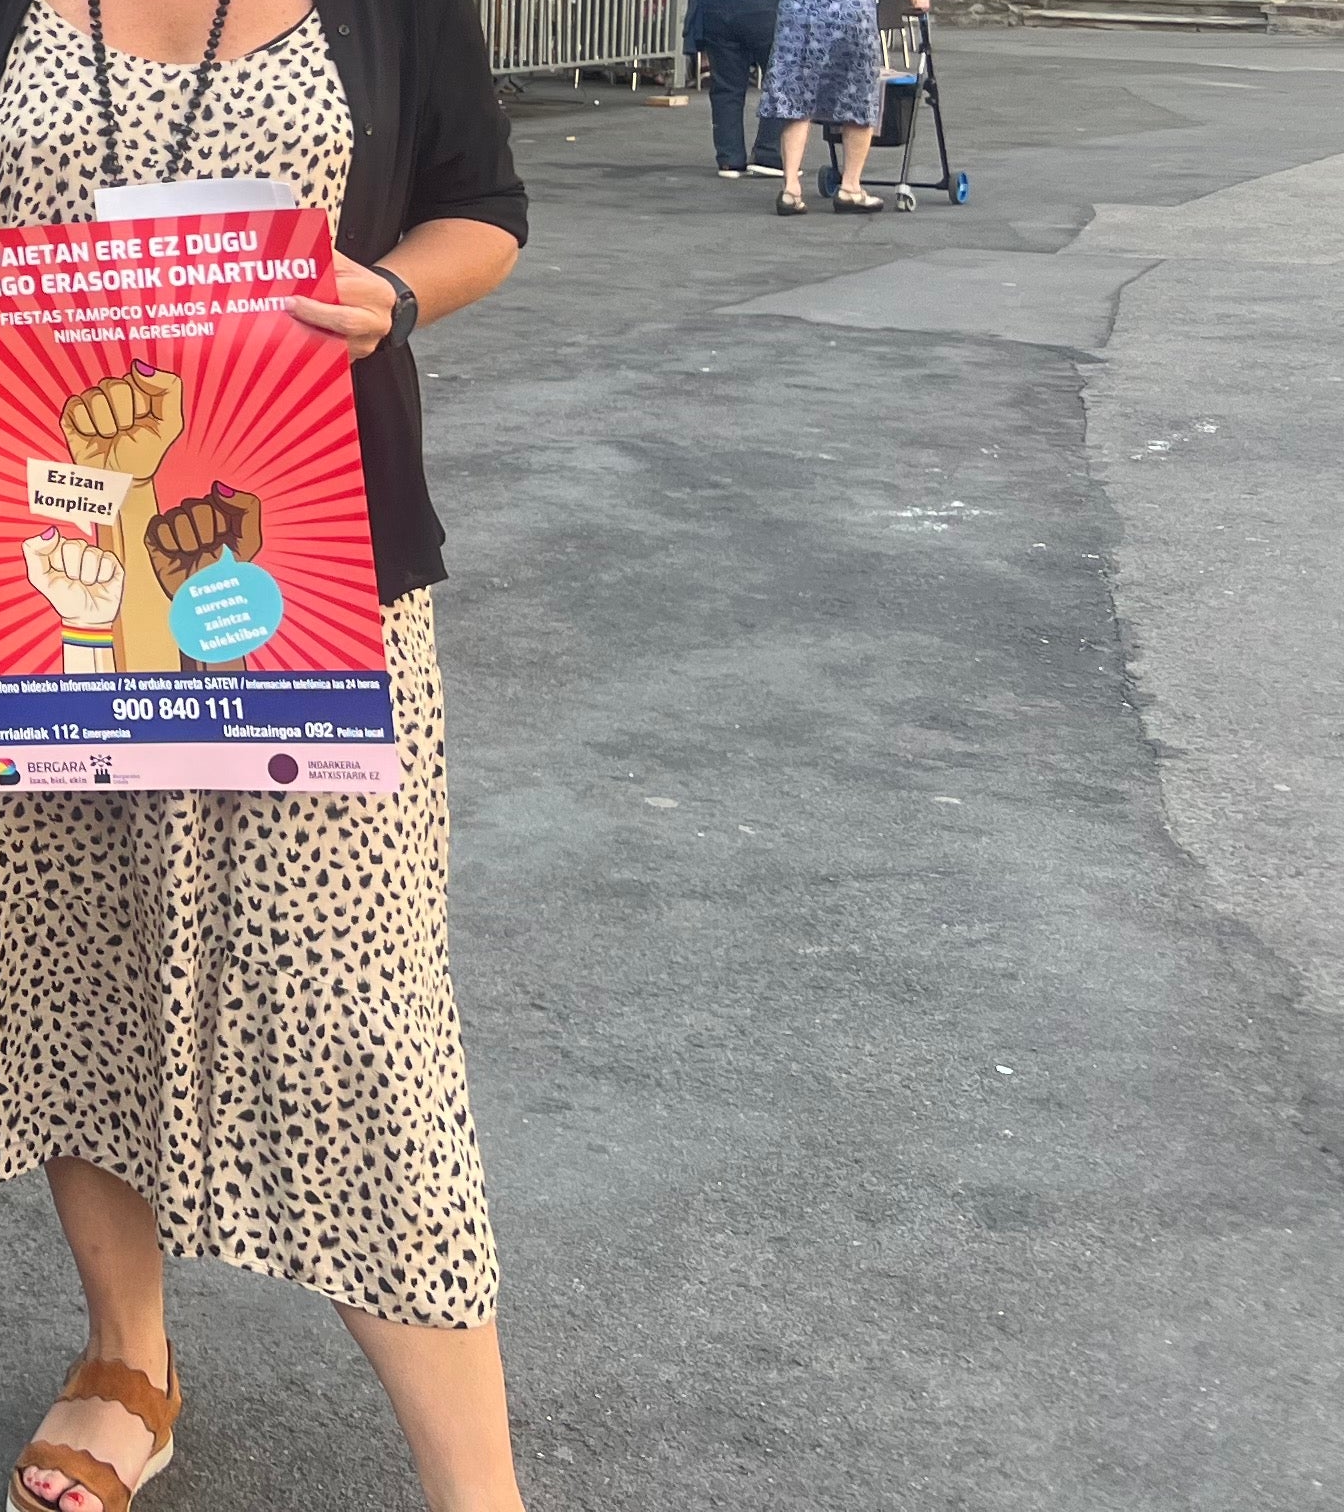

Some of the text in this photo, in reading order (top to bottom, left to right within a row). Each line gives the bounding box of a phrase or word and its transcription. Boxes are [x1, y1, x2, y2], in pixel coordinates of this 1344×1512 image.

[95, 239, 142, 262] ERE
[148, 237, 179, 258] EZ
[185, 230, 258, 255] DUGU
[41, 267, 163, 295] ERASORIK
[168, 258, 317, 288] ONARTUKO!
[0, 307, 62, 326] FIESTAS
[66, 304, 143, 323] TAMPOCO
[146, 300, 206, 319] VAMOS
[209, 299, 223, 315] A
[226, 296, 286, 314] ADMITI
[54, 321, 215, 345] NINGUNA AGRESIÓN!
[47, 469, 104, 491] Ez izan
[34, 490, 113, 516] konplize!
[189, 577, 240, 598] Erasoen
[194, 594, 249, 616] aurrean,
[204, 612, 251, 632] zaintza
[199, 626, 268, 652] kolektiboa
[21, 680, 58, 693] bidezko
[124, 679, 137, 691] 24
[138, 678, 172, 691] orduko
[174, 678, 203, 690] arreta
[204, 677, 238, 690] SATEVI
[345, 679, 356, 689] 24
[112, 697, 244, 720] 900 840 111
[52, 724, 80, 740] 112
[223, 724, 302, 740] Udaltzaingoa
[305, 722, 334, 738] 092
[28, 761, 87, 773] BERGARA
[308, 760, 361, 770] INDARKERIA
[308, 771, 380, 781] MATXISTARIK EZ
